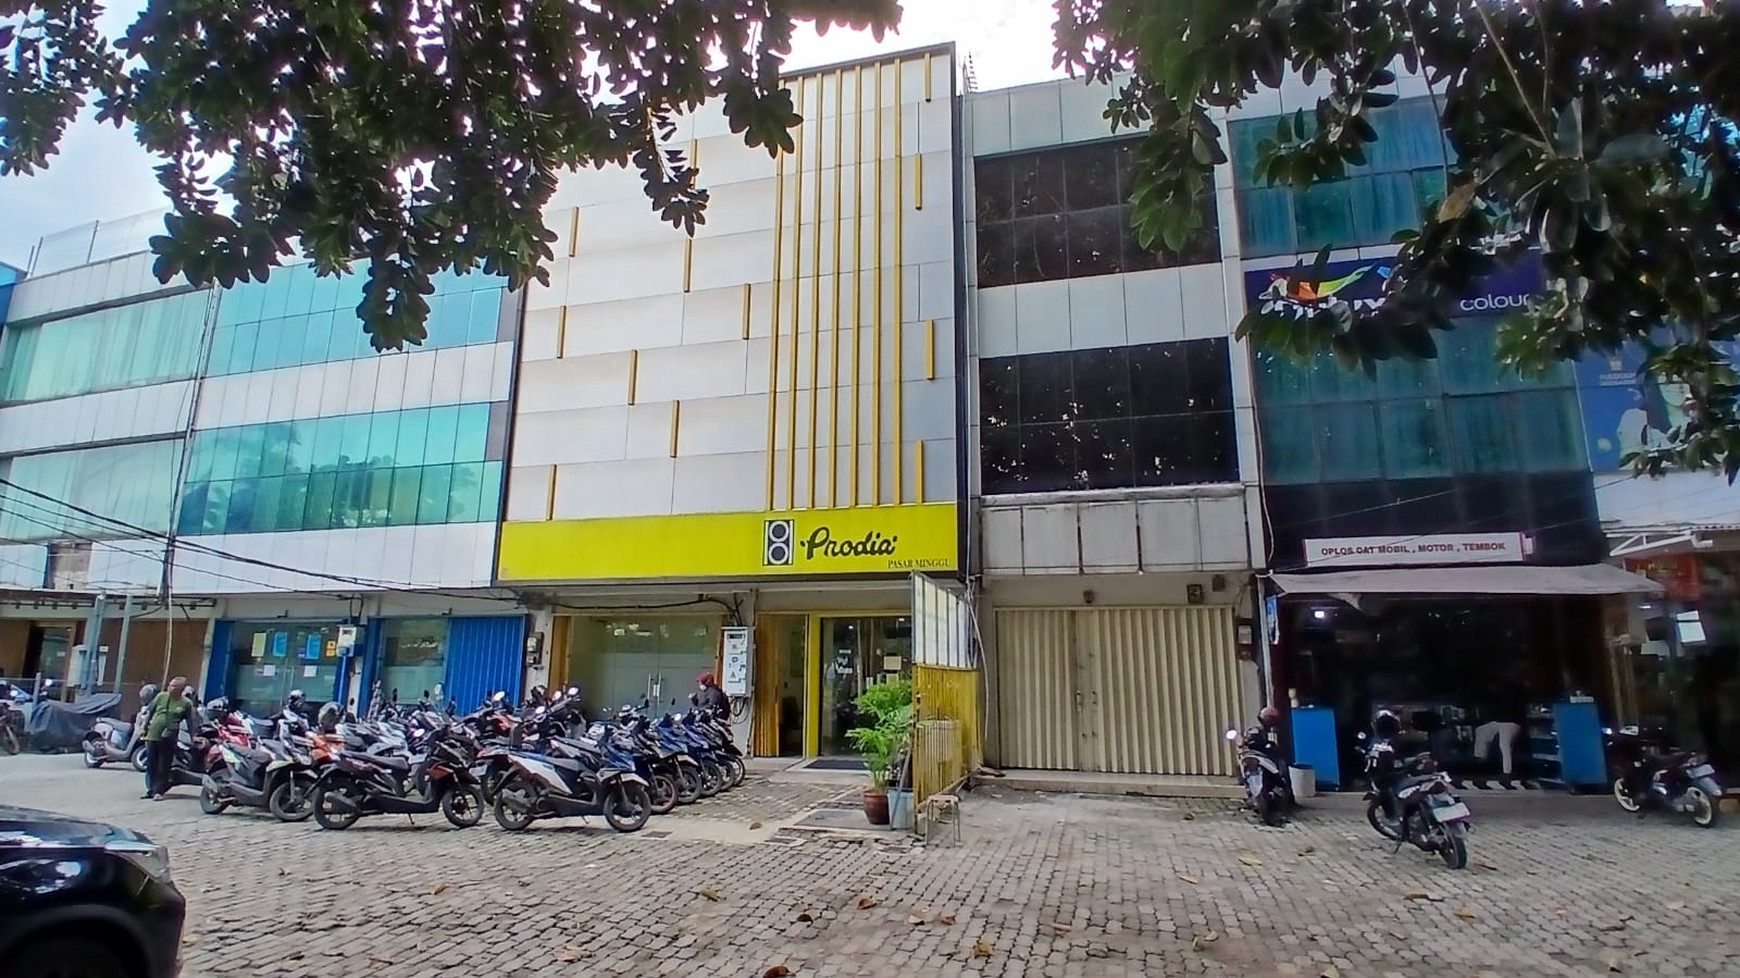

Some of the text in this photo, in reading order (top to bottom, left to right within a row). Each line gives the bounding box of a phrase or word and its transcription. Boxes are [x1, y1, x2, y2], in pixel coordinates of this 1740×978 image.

[801, 526, 897, 560] Prodia
[1418, 543, 1454, 552] MOTOR
[1462, 542, 1506, 551] TEMBOK
[888, 558, 949, 569] PASAR MINGGU
